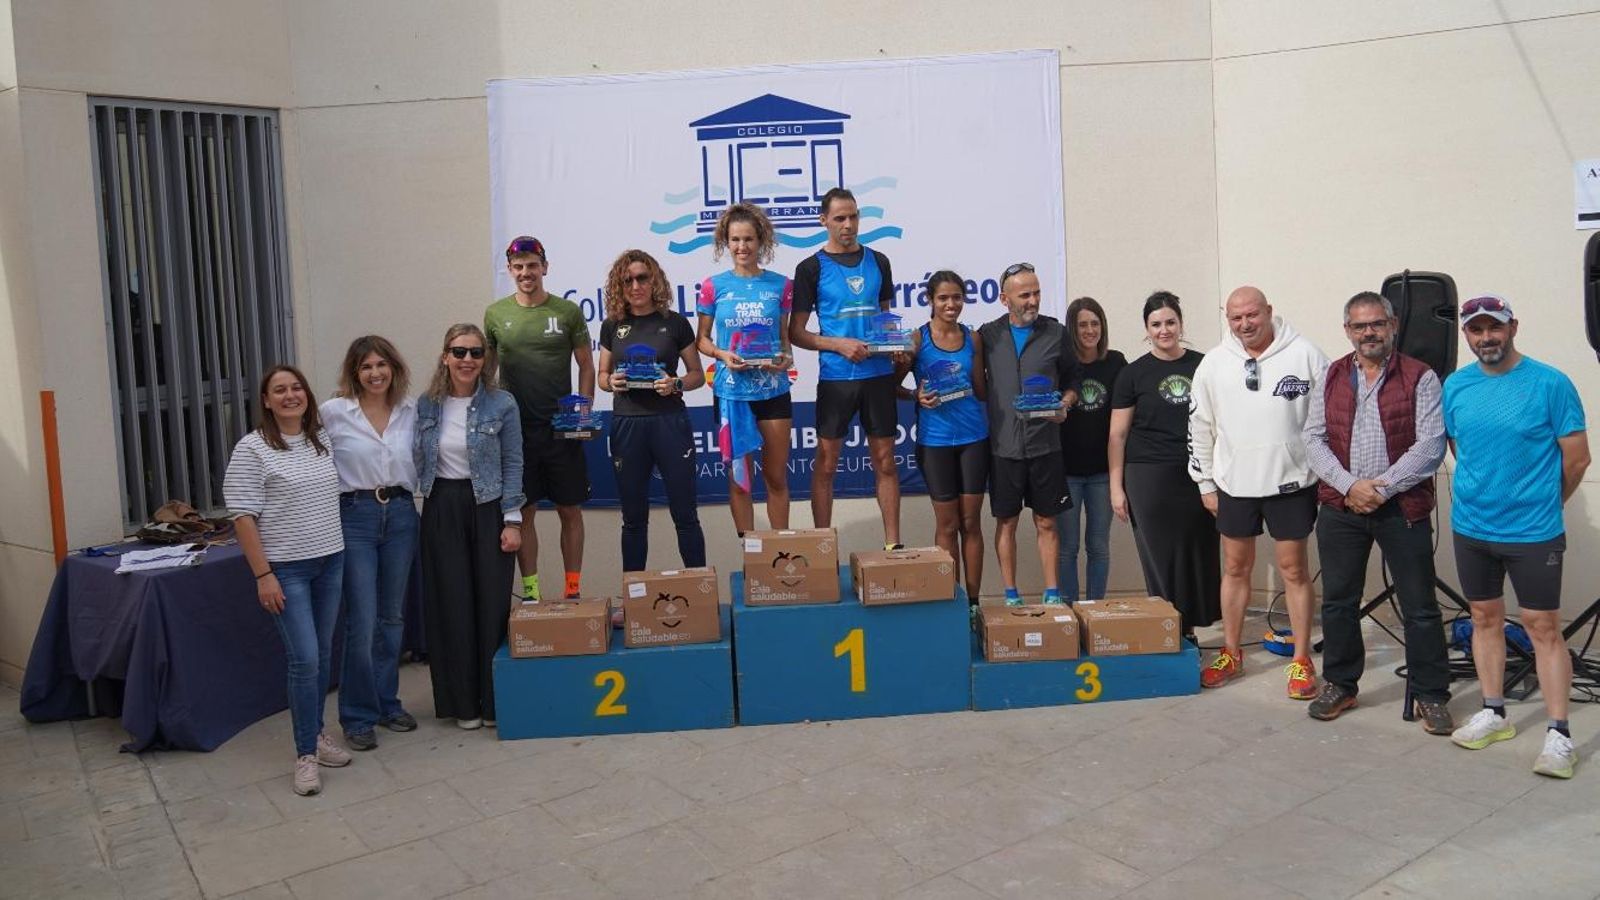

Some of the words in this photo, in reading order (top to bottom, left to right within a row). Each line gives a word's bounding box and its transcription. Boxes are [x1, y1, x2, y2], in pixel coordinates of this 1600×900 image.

[737, 125, 803, 137] COLEGIO
[702, 138, 844, 207] LICEO
[736, 301, 765, 311] ADRA
[736, 309, 764, 318] TRAIL
[725, 317, 774, 328] RUNNING
[834, 628, 866, 692] 1
[594, 670, 628, 716] 2
[1075, 661, 1102, 701] 3
